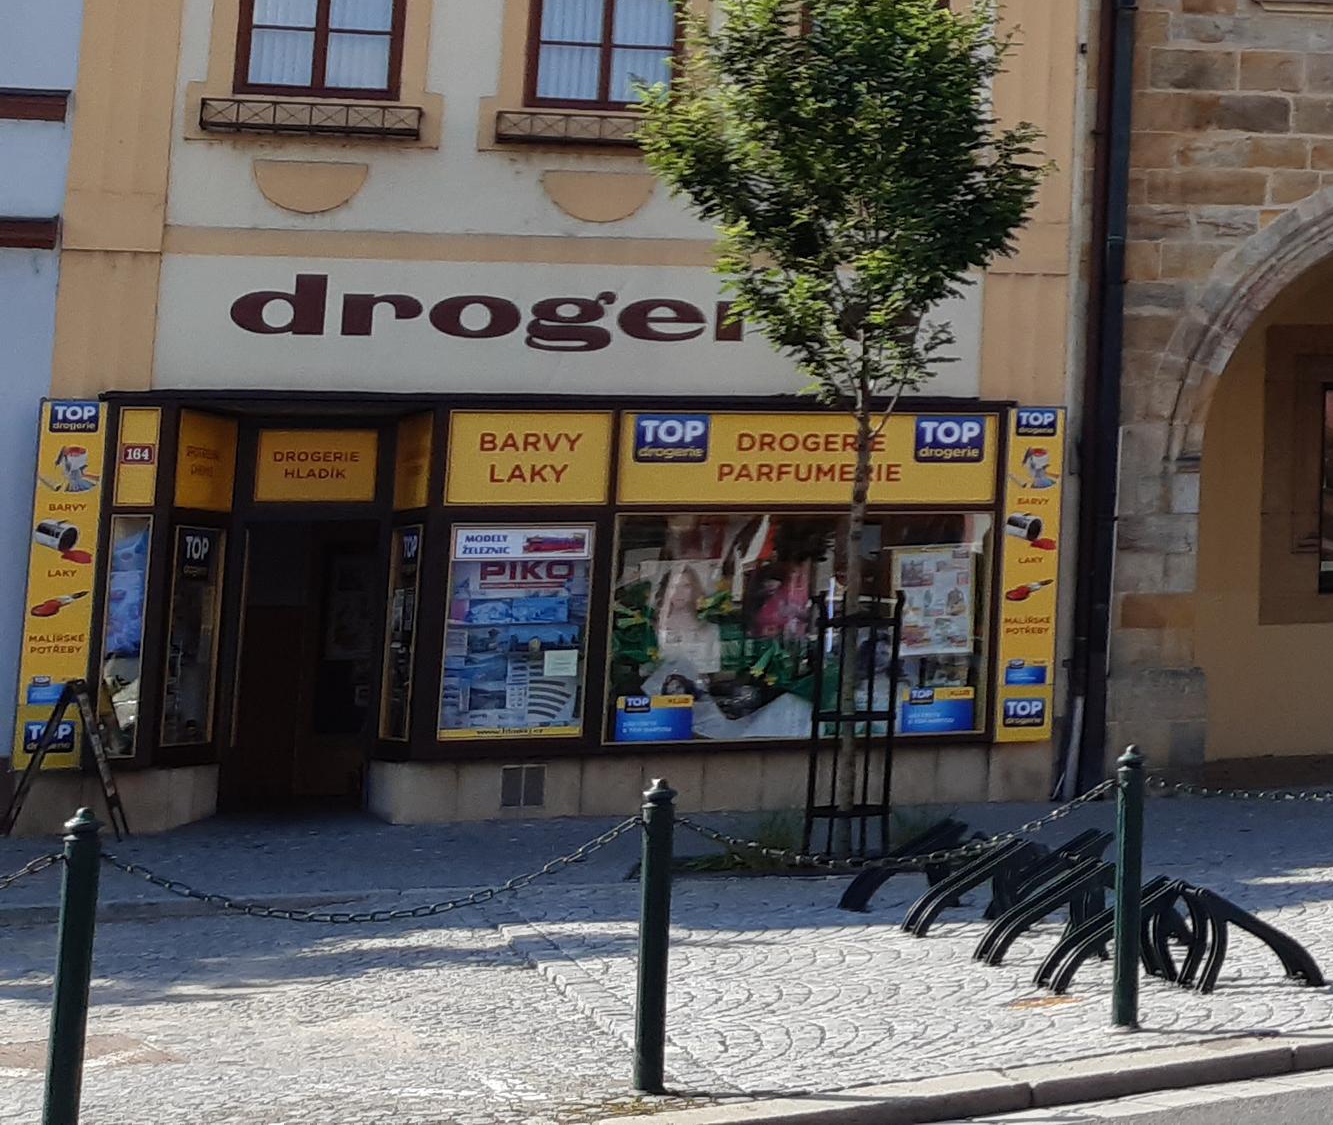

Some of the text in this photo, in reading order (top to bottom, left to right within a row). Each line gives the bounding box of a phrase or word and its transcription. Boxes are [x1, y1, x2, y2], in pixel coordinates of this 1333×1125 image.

[54, 405, 97, 421] TOP
[1018, 411, 1055, 426] TOP
[52, 421, 96, 431] drogerie
[639, 420, 705, 443] TOP
[919, 421, 980, 443] TOP
[1017, 427, 1054, 435] drogerie
[479, 432, 583, 452] BARVY
[736, 432, 886, 453] DROGERE
[126, 448, 150, 461] 164
[273, 450, 361, 463] DROGERIE
[637, 444, 704, 459] drogerie
[918, 445, 980, 459] drogerie
[284, 467, 346, 480] HLADÍK
[489, 463, 569, 484] LAKY
[48, 503, 87, 512] BARVY
[1016, 497, 1050, 506] BARVY
[464, 534, 509, 544] MODELY
[185, 535, 210, 561] TOP
[403, 534, 418, 558] TOP
[462, 545, 511, 556] ŽELEZNIC
[1017, 556, 1044, 565] LAKY
[47, 569, 77, 578] LAKY
[479, 561, 575, 581] PIKO
[30, 644, 82, 654] POTŘEBY
[911, 689, 934, 698] TOP
[626, 697, 649, 707] TOP
[1006, 700, 1043, 716] TOP
[1005, 716, 1042, 725] drogerie
